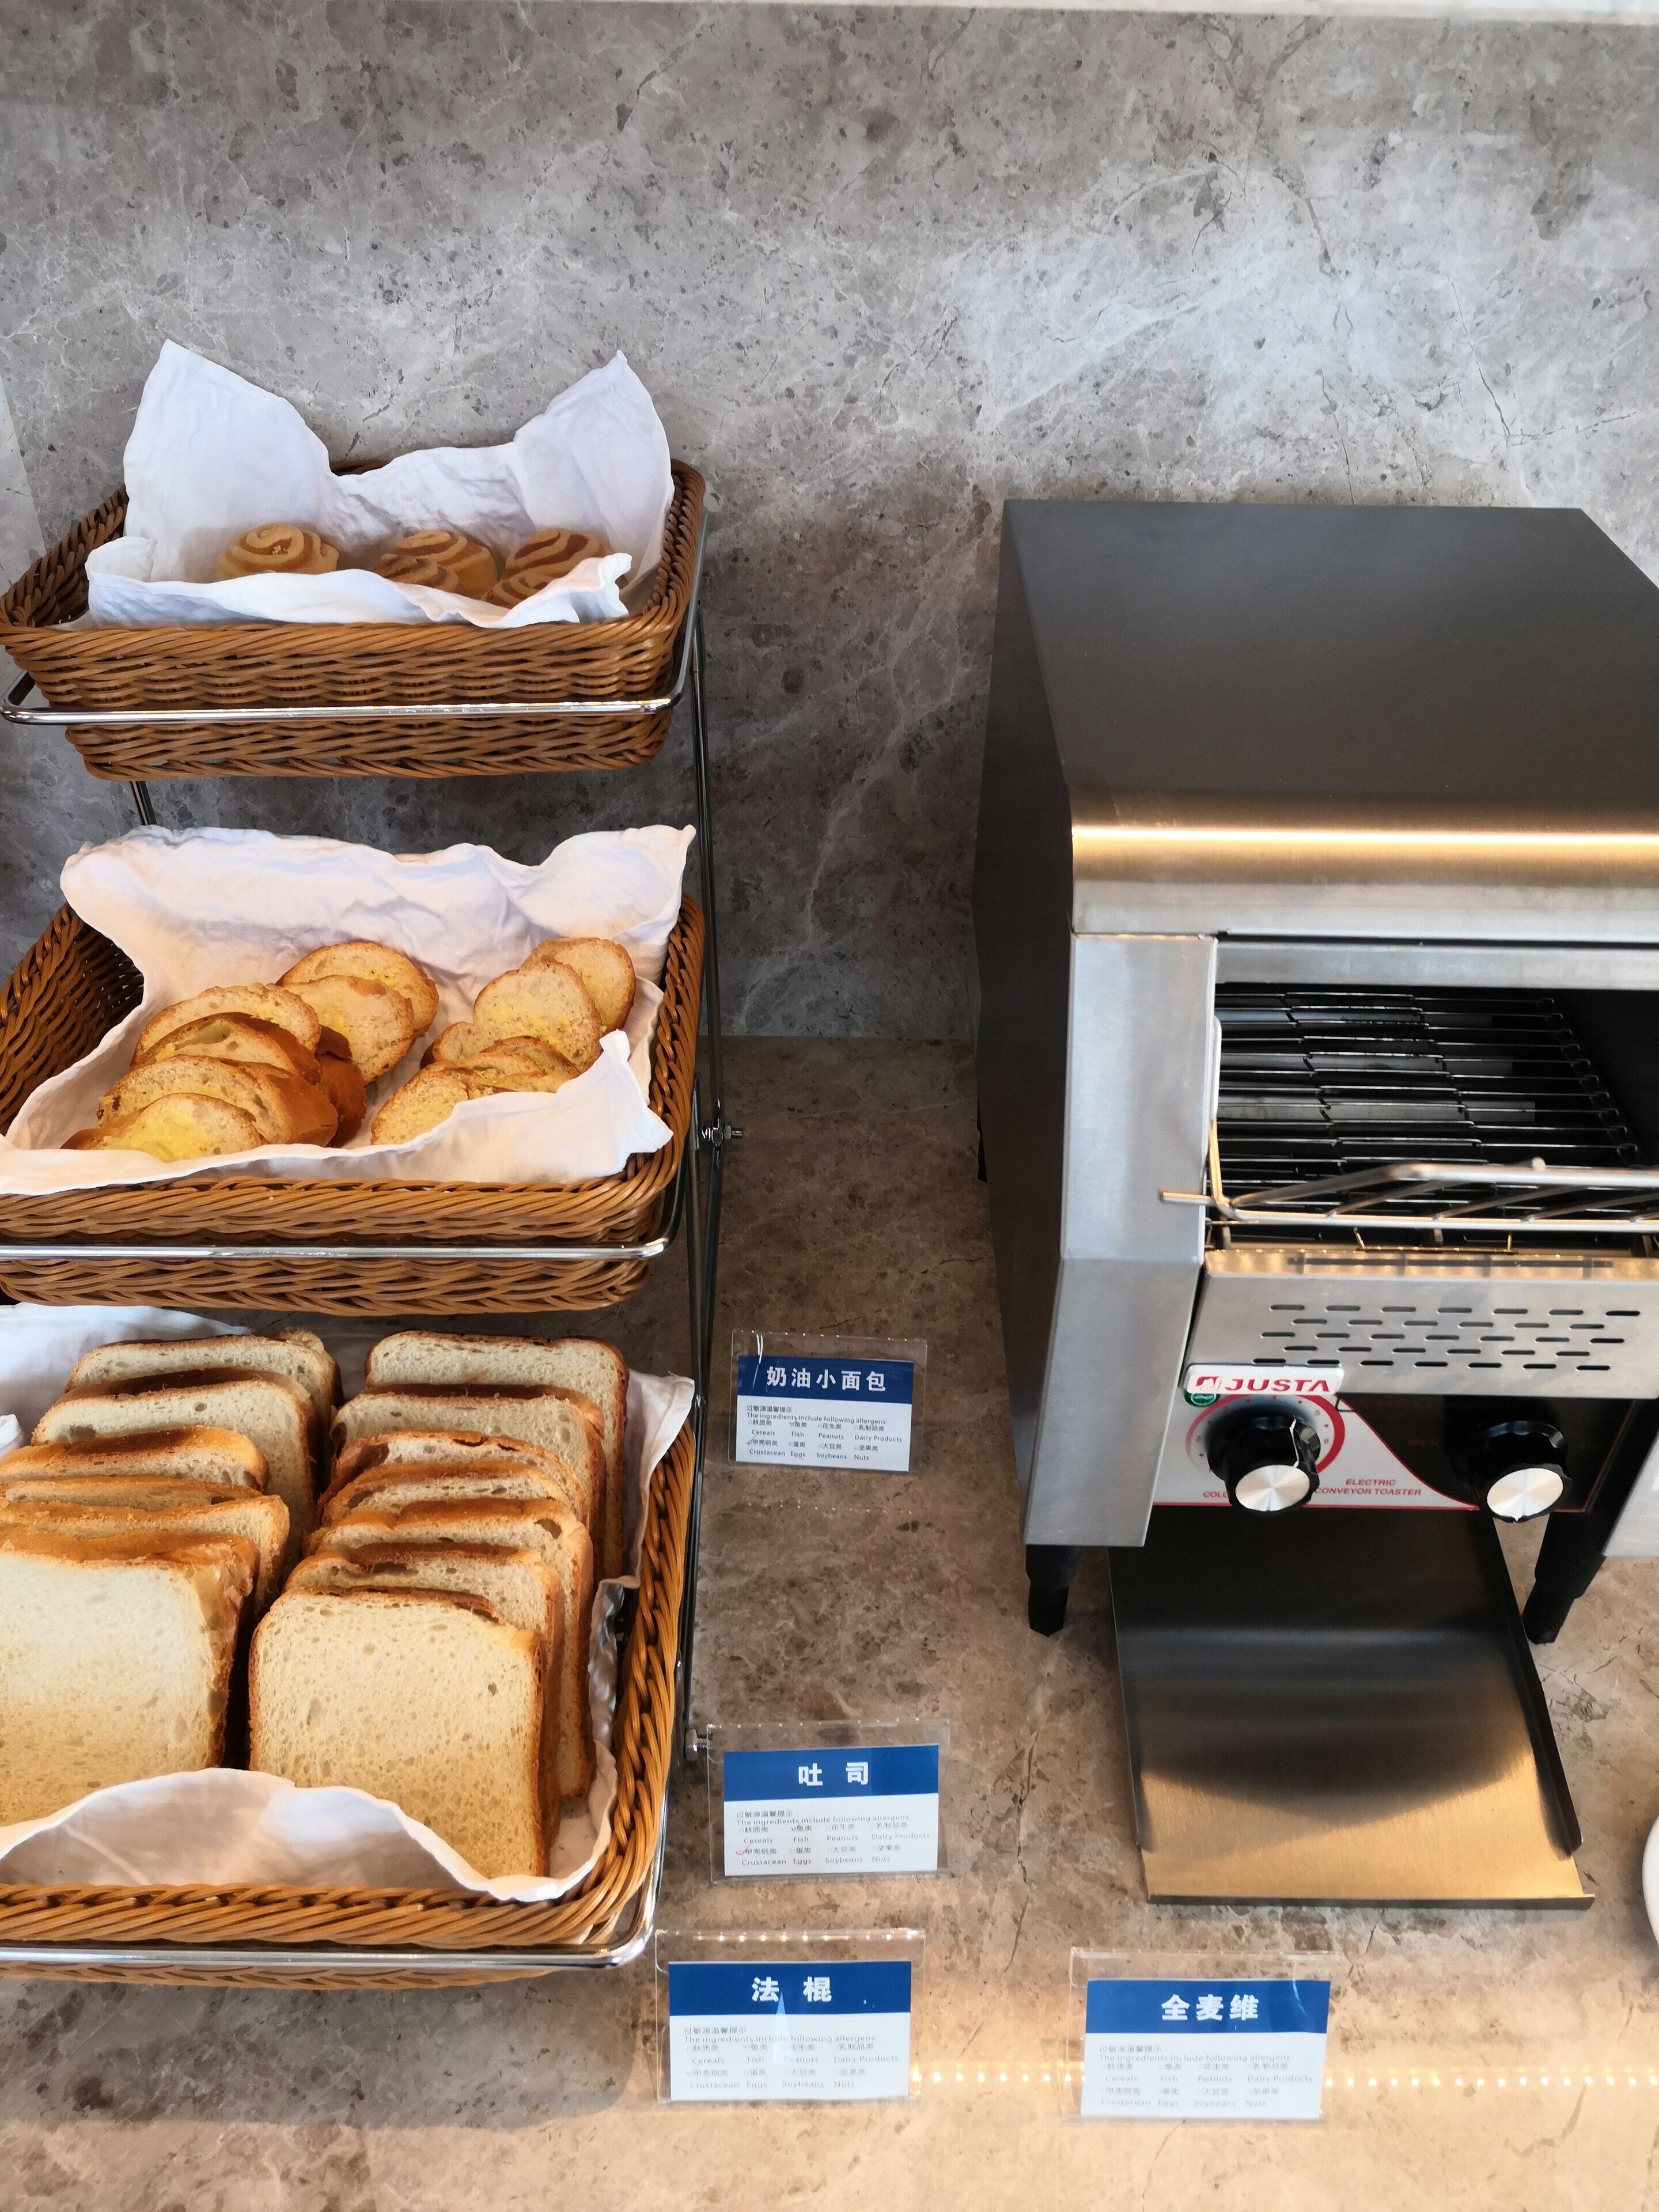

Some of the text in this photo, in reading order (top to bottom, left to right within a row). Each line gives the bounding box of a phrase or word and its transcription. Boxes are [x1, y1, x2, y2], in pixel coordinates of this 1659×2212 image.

[767, 1366, 886, 1392] 奶油小面包
[1225, 1378, 1330, 1392] JUSTA
[824, 1416, 854, 1425] following
[1345, 1478, 1396, 1486] ELECTRIC
[1315, 1487, 1422, 1496] CONVEYOR TOASTER
[798, 1762, 869, 1786] 吐司
[753, 1818, 799, 1826] ingredients
[752, 1976, 832, 2002] 法棍
[1161, 1994, 1259, 2021] 全麦维
[703, 2036, 753, 2044] ingredients
[791, 2035, 832, 2043] following
[1206, 2054, 1247, 2062] following
[1273, 2074, 1313, 2082] Products
